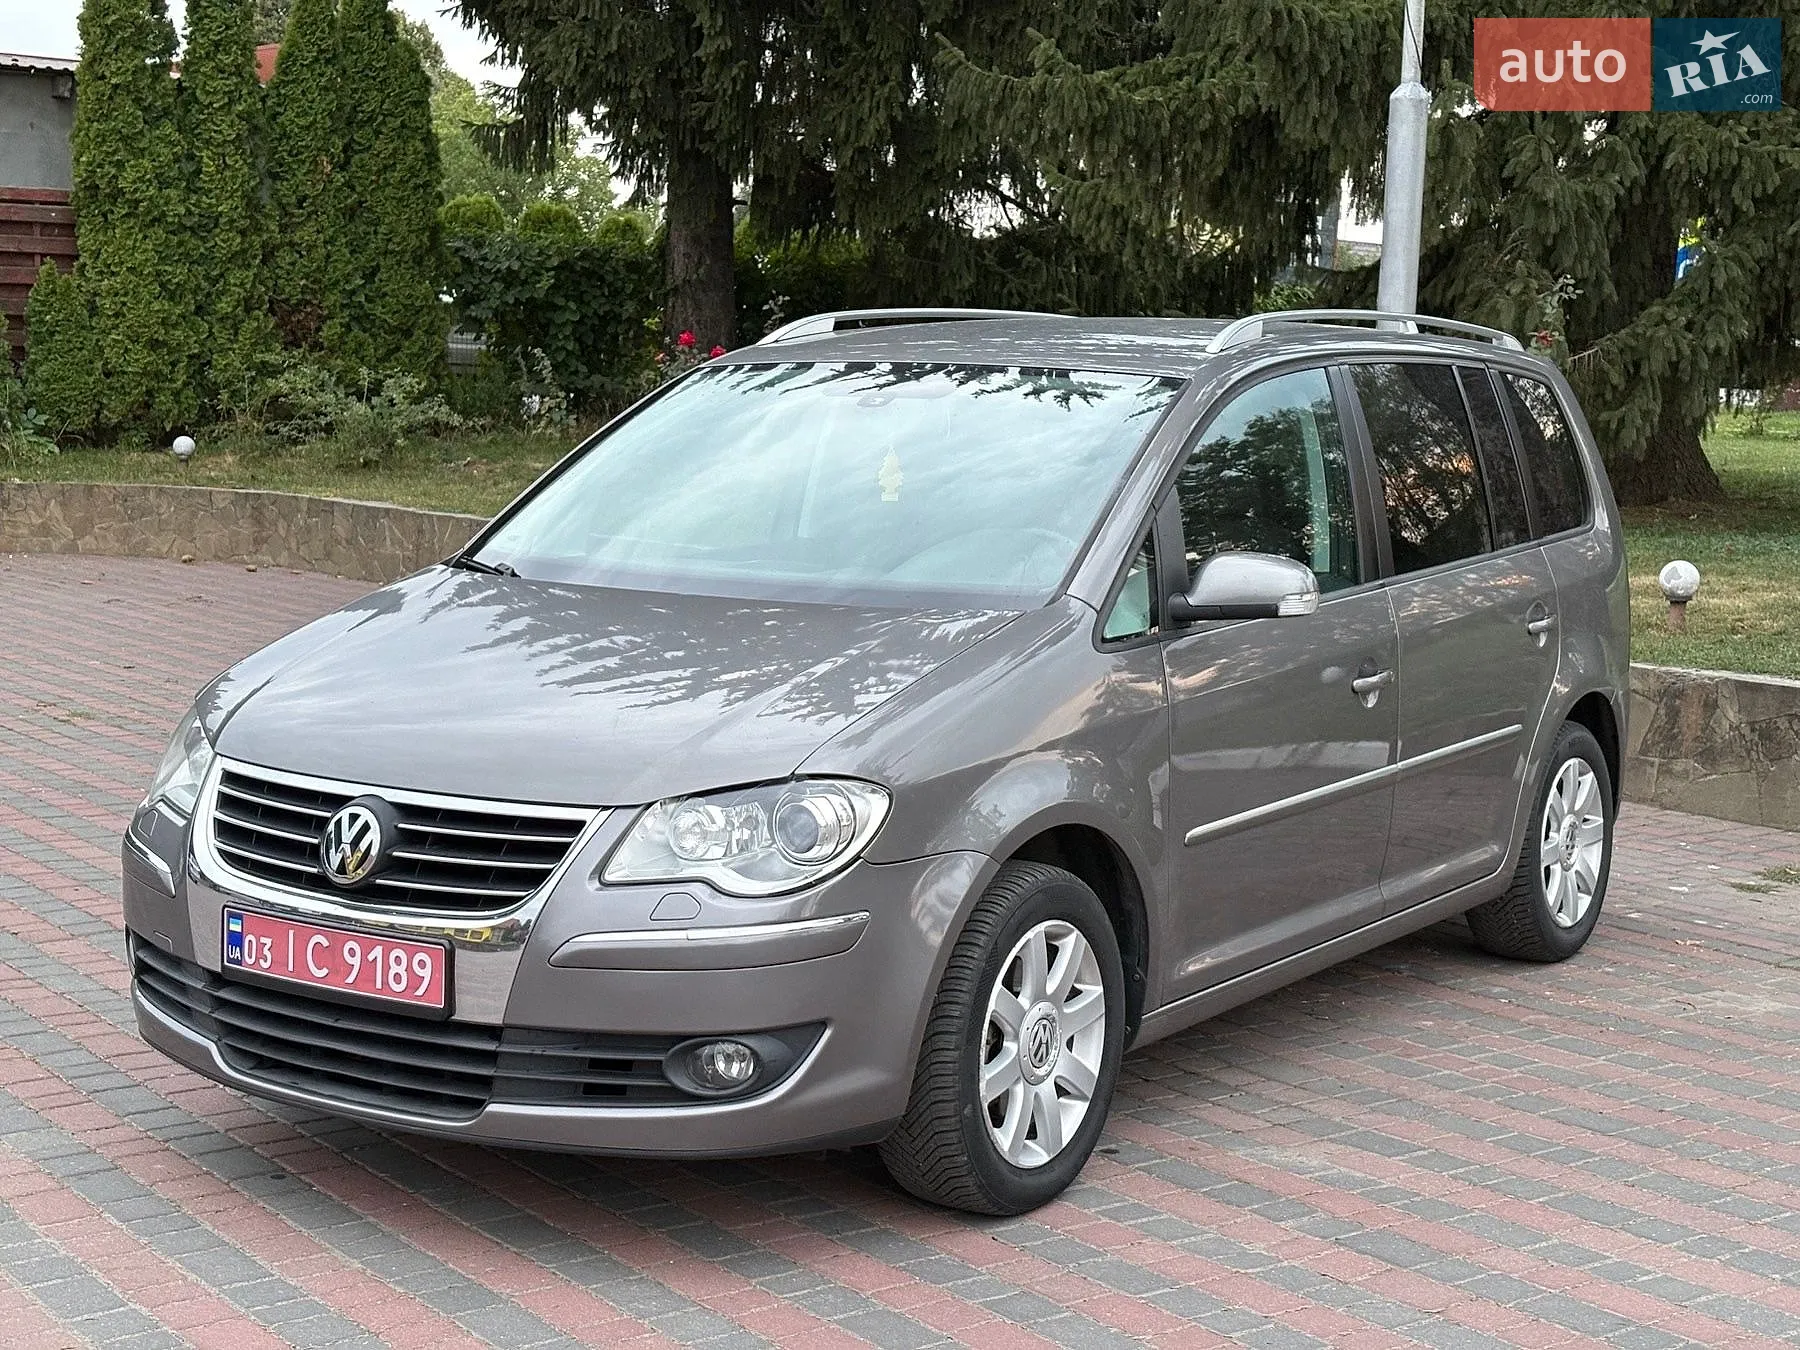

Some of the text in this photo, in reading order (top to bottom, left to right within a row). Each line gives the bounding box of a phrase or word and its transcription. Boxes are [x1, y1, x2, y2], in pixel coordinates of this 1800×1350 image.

[325, 806, 382, 882] VW
[228, 944, 241, 961] UA
[244, 934, 273, 969] 03
[342, 940, 432, 996] 9189
